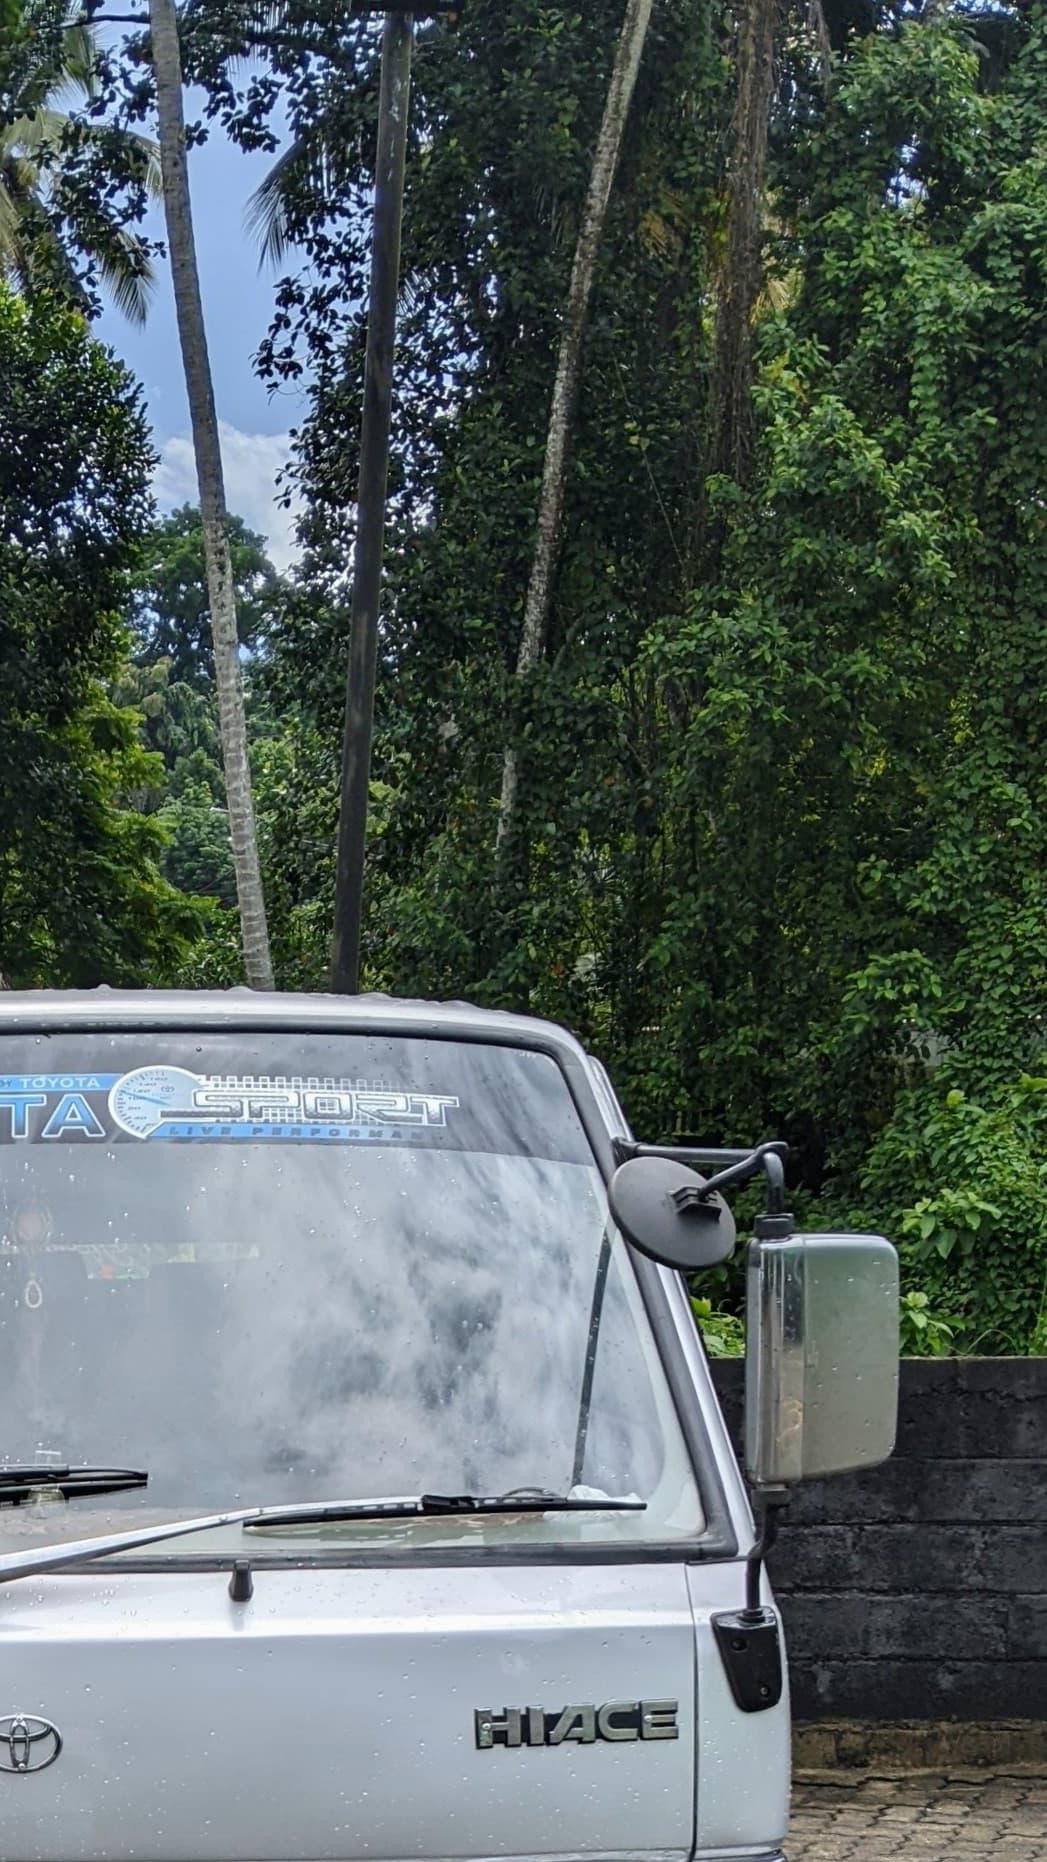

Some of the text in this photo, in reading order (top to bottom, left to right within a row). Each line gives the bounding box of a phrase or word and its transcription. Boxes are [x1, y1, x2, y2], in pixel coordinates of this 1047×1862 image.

[21, 1076, 101, 1089] TOYOTA
[159, 1089, 460, 1127] SPORT
[169, 1126, 232, 1136] LIVE
[474, 1699, 679, 1750] HIACE
